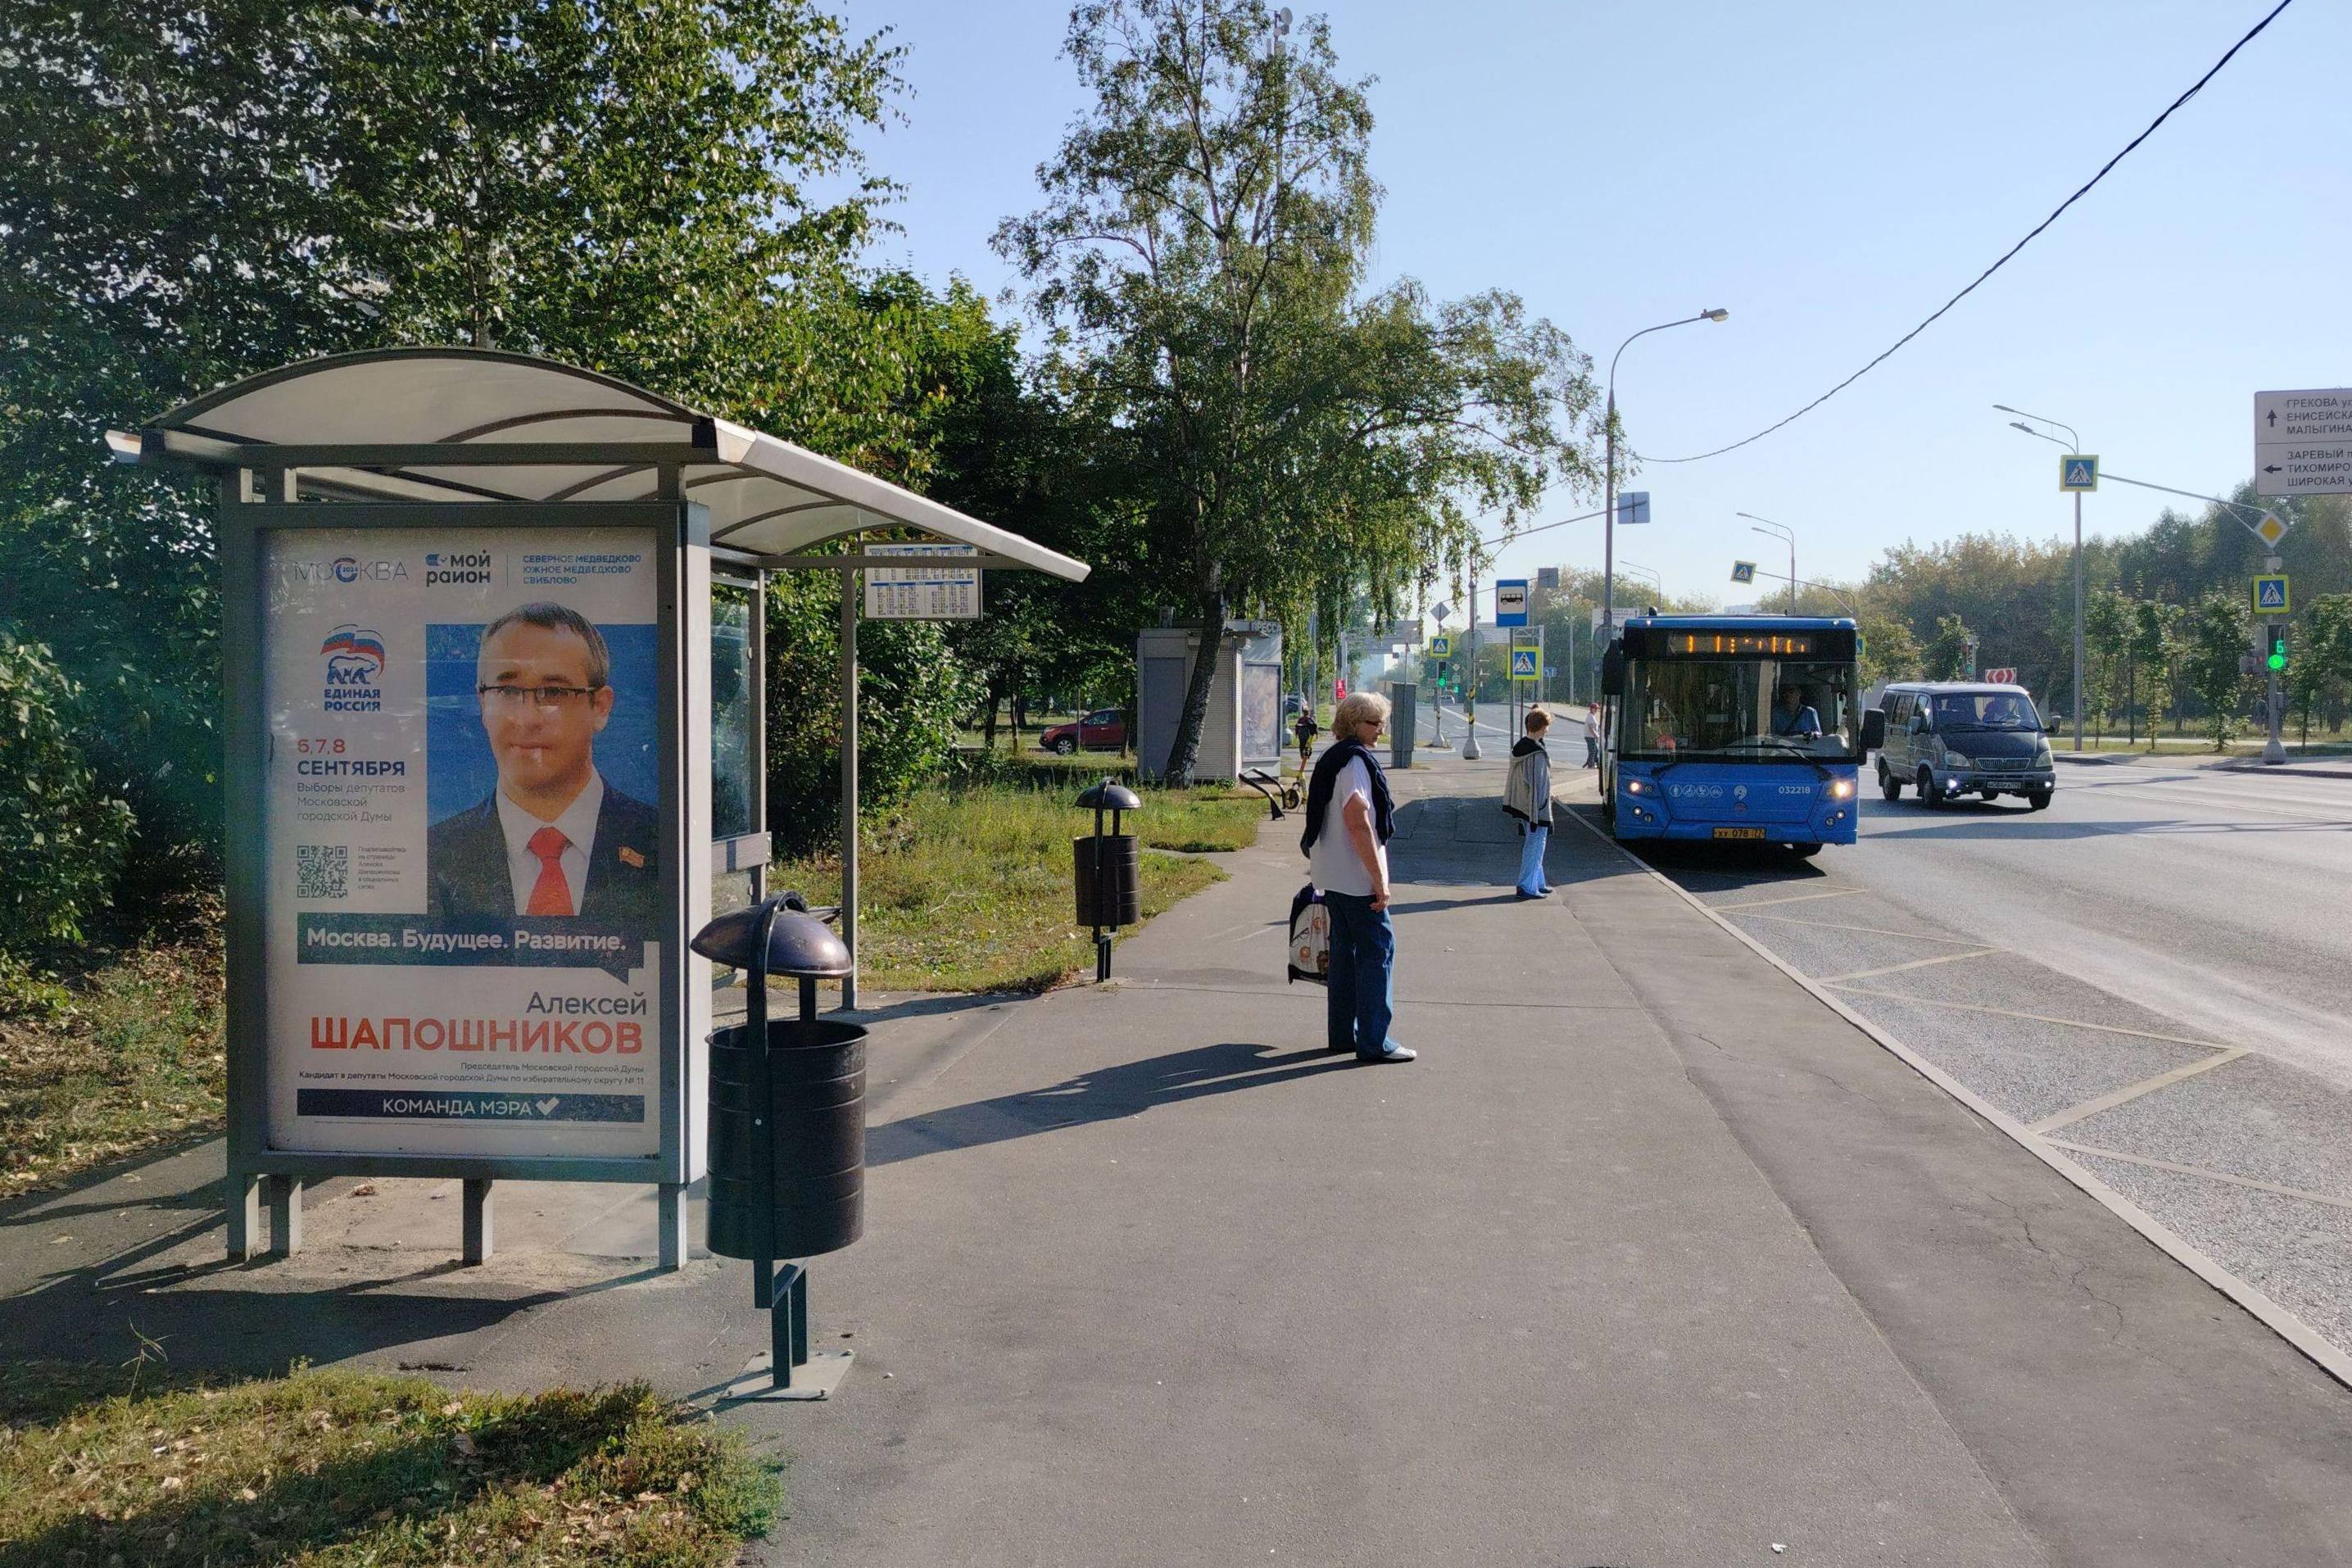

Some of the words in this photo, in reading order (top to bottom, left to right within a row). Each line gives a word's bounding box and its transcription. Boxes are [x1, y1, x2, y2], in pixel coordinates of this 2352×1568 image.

[2286, 398, 2338, 409] ГРЕКОВА
[2286, 424, 2352, 434] МАЛЫГИНА
[2287, 448, 2344, 460] ЗАРЕВЫЙ
[2287, 476, 2344, 487] ШИРОКАЯ
[450, 550, 490, 567] мой
[575, 555, 641, 564] МЕДВЕДКОВО
[294, 557, 409, 582] МОСКВА
[523, 565, 561, 573] ЮЖНОЕ
[564, 565, 632, 574] МЕДВЕДКОВО
[523, 576, 578, 584] СВИБЛОВО
[324, 689, 381, 700] ЕДИНАЯ
[324, 700, 381, 711] РОССИЯ
[297, 760, 406, 776] СЕНТЯБРЯ
[297, 782, 342, 793] Выборы
[346, 784, 406, 795] депутатов
[1778, 786, 1811, 795] 032218
[297, 795, 368, 807] Московской
[297, 810, 358, 823] городской
[360, 812, 393, 823] Думы
[307, 927, 397, 948] Москва.
[402, 929, 508, 953] Будущее.
[514, 931, 627, 950] Развитие.
[526, 991, 647, 1016] Алексей
[311, 1017, 642, 1054] ШАПОШНИКОВ
[388, 1072, 437, 1081] Московской
[383, 1099, 476, 1116] КОМАНДА
[480, 1100, 532, 1116] МЭРА
